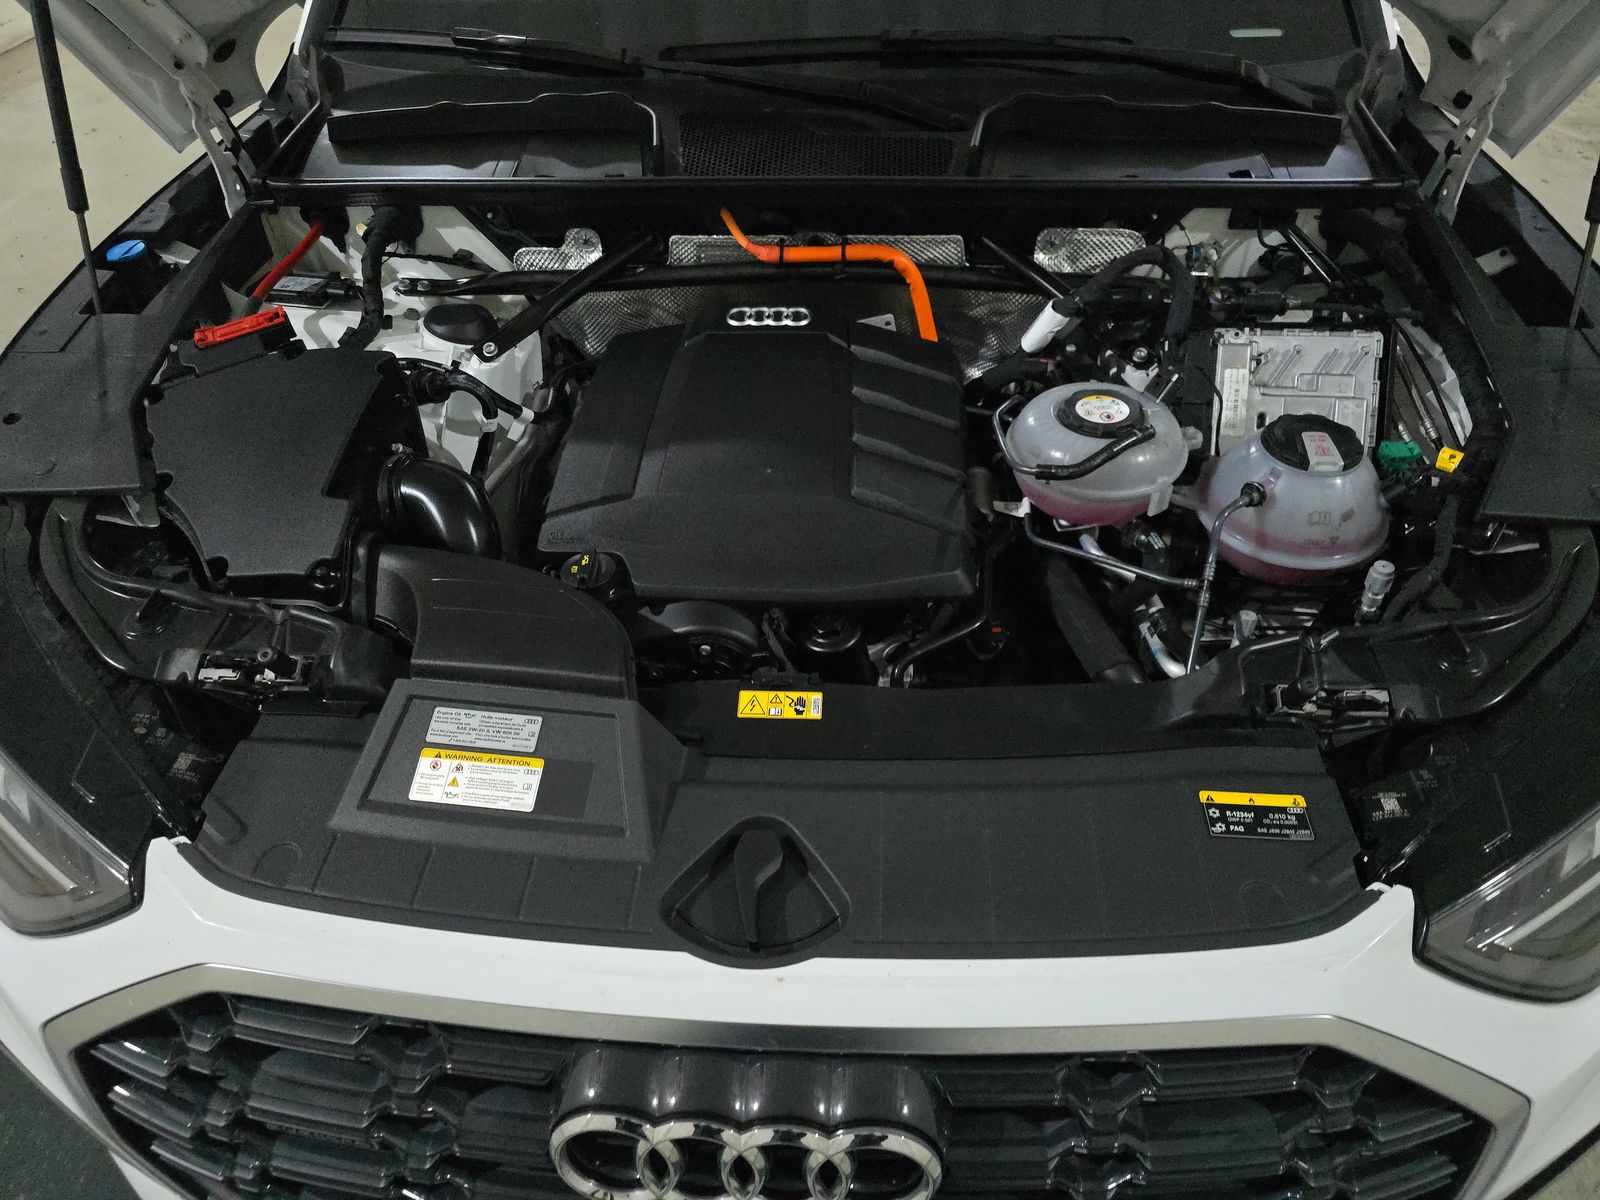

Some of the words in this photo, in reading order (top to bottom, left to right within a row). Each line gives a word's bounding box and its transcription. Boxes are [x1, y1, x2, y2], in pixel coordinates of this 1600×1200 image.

[444, 752, 483, 763] WARNING
[487, 756, 531, 767] ATTENTION
[1225, 810, 1254, 819] R-1234yf
[1287, 813, 1296, 821] kg
[1229, 824, 1245, 833] PAG
